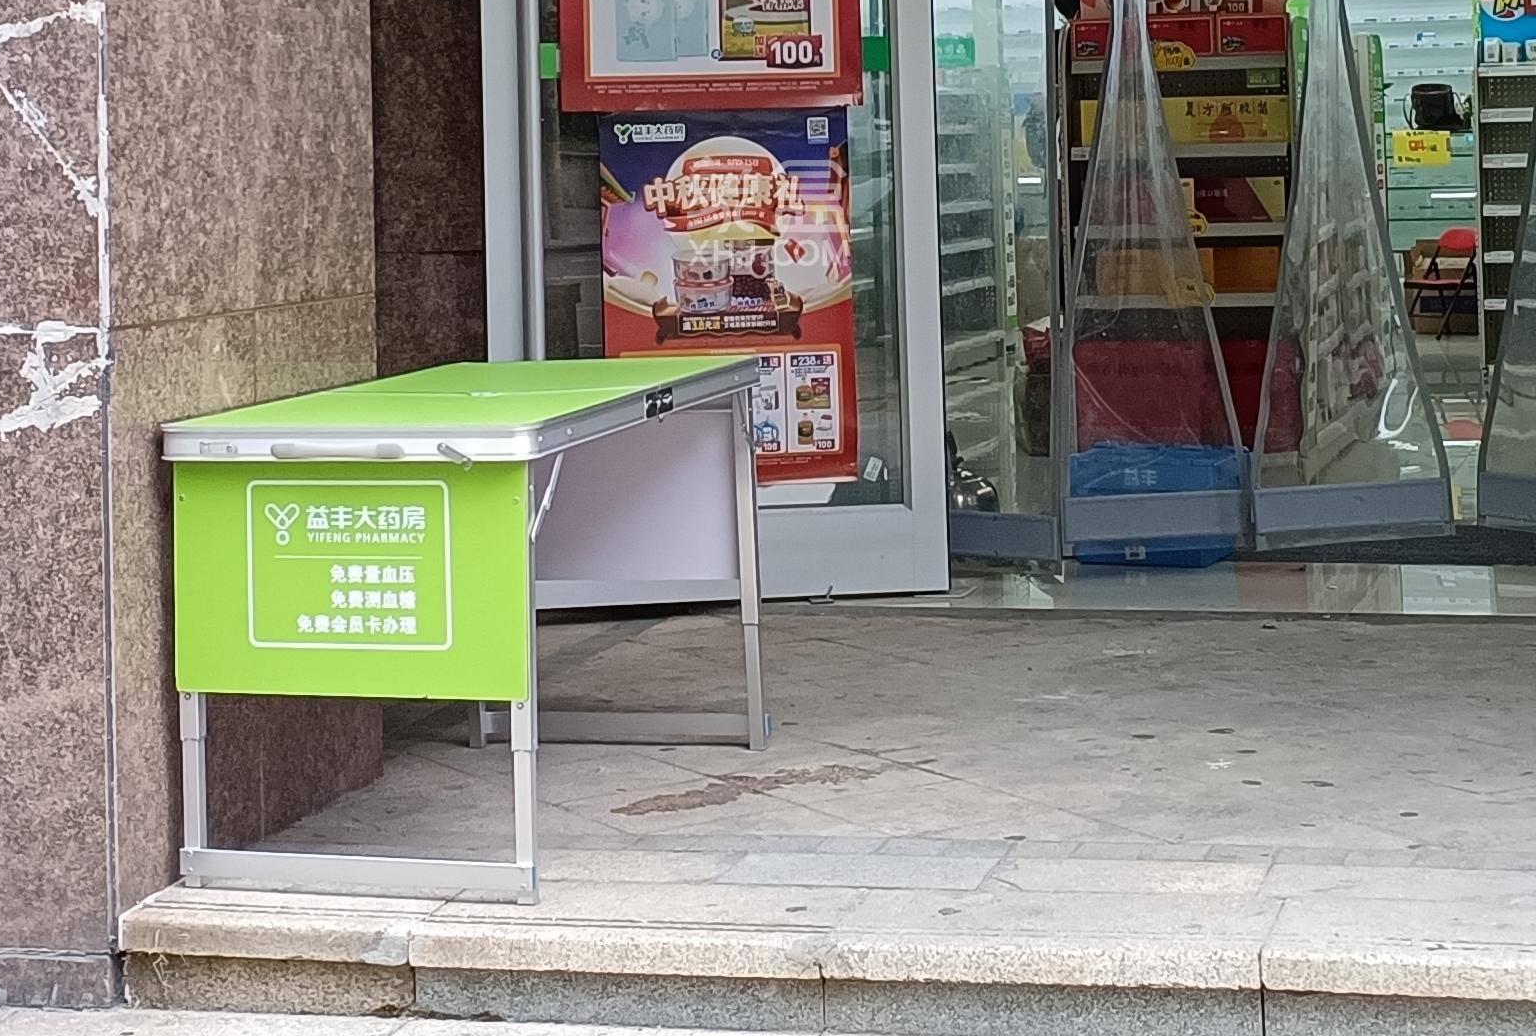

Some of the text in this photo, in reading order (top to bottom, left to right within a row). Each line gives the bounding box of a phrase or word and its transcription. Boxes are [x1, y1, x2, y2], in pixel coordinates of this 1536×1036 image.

[770, 39, 813, 65] 100
[644, 172, 805, 215] 中秋健康礼
[305, 504, 427, 531] 益丰大药房
[306, 531, 427, 545] YIFENG PHARMACY
[329, 565, 416, 585] 免费量血压
[330, 590, 417, 610] 免费测血糖
[296, 614, 418, 636] 免费会员卡办理
